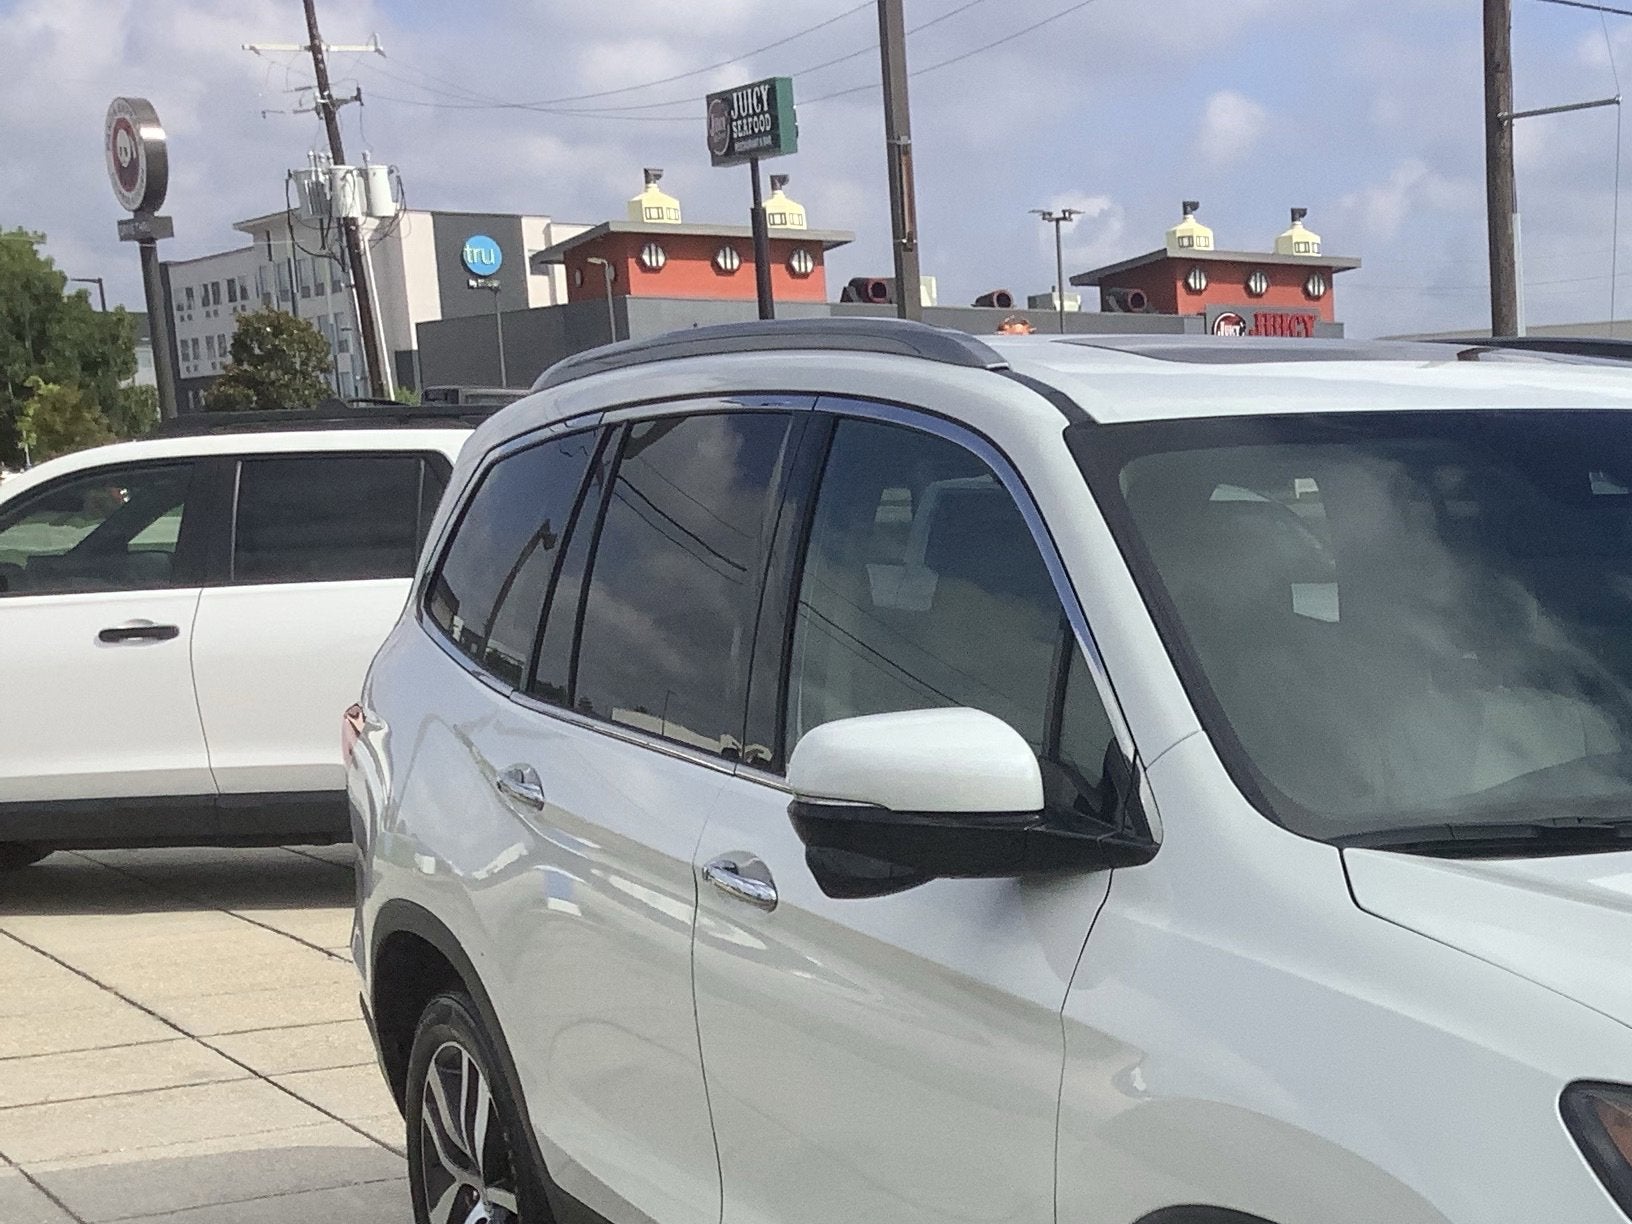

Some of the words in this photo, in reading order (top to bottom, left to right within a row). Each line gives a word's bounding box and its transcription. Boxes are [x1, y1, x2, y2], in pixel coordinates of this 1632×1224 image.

[731, 85, 769, 119] JUICY
[732, 113, 771, 138] SEAFOOD
[464, 244, 495, 265] tru
[1249, 312, 1316, 337] JUICY
